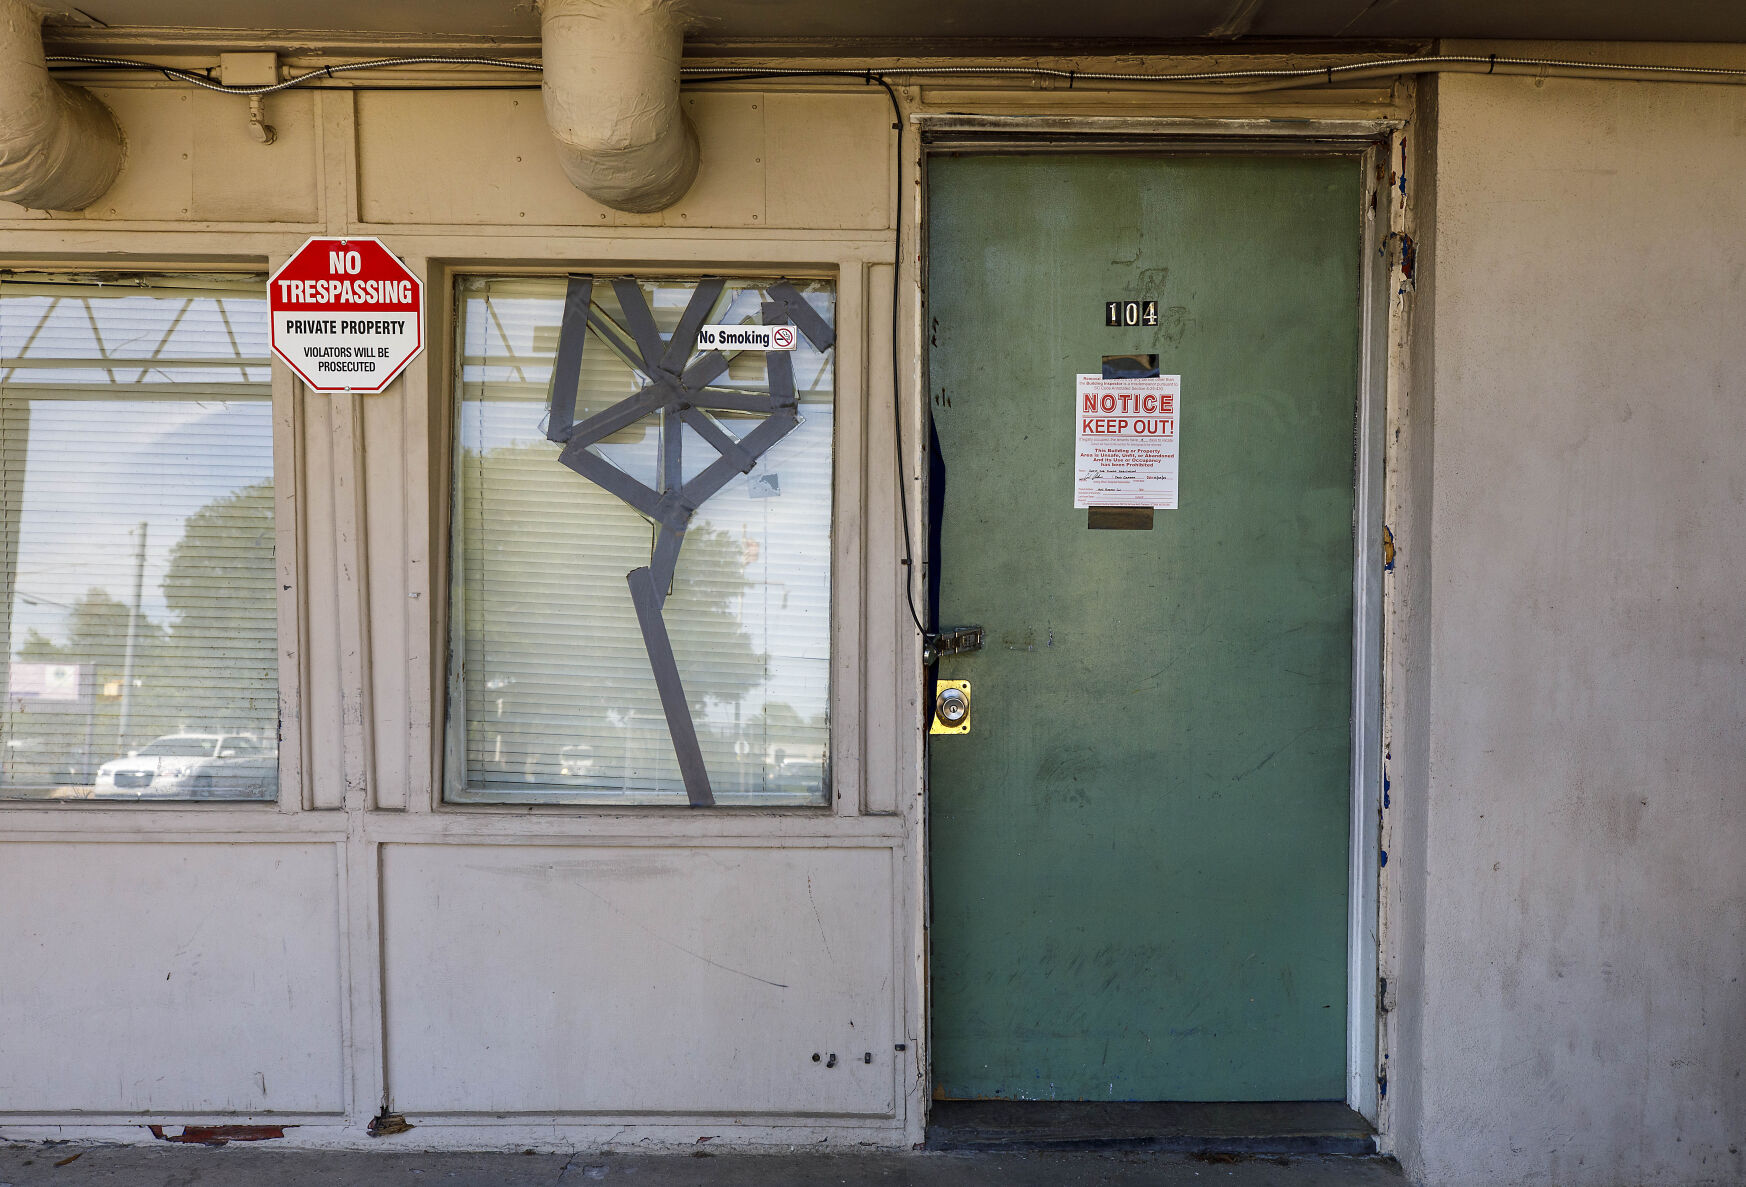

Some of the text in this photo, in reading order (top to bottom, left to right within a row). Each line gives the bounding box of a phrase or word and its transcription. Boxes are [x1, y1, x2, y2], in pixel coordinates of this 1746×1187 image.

[329, 251, 361, 275] NO
[278, 280, 412, 304] TRESPASSING
[1109, 302, 1158, 326] 104
[286, 320, 405, 335] PRIVATE PROPERTY
[699, 330, 770, 347] No Smoking
[303, 346, 389, 358] VIOLATORS WILL BE
[318, 361, 376, 372] PROSECUTED
[1082, 393, 1174, 414] NOTICE
[1082, 419, 1174, 435] KEEP OUT!
